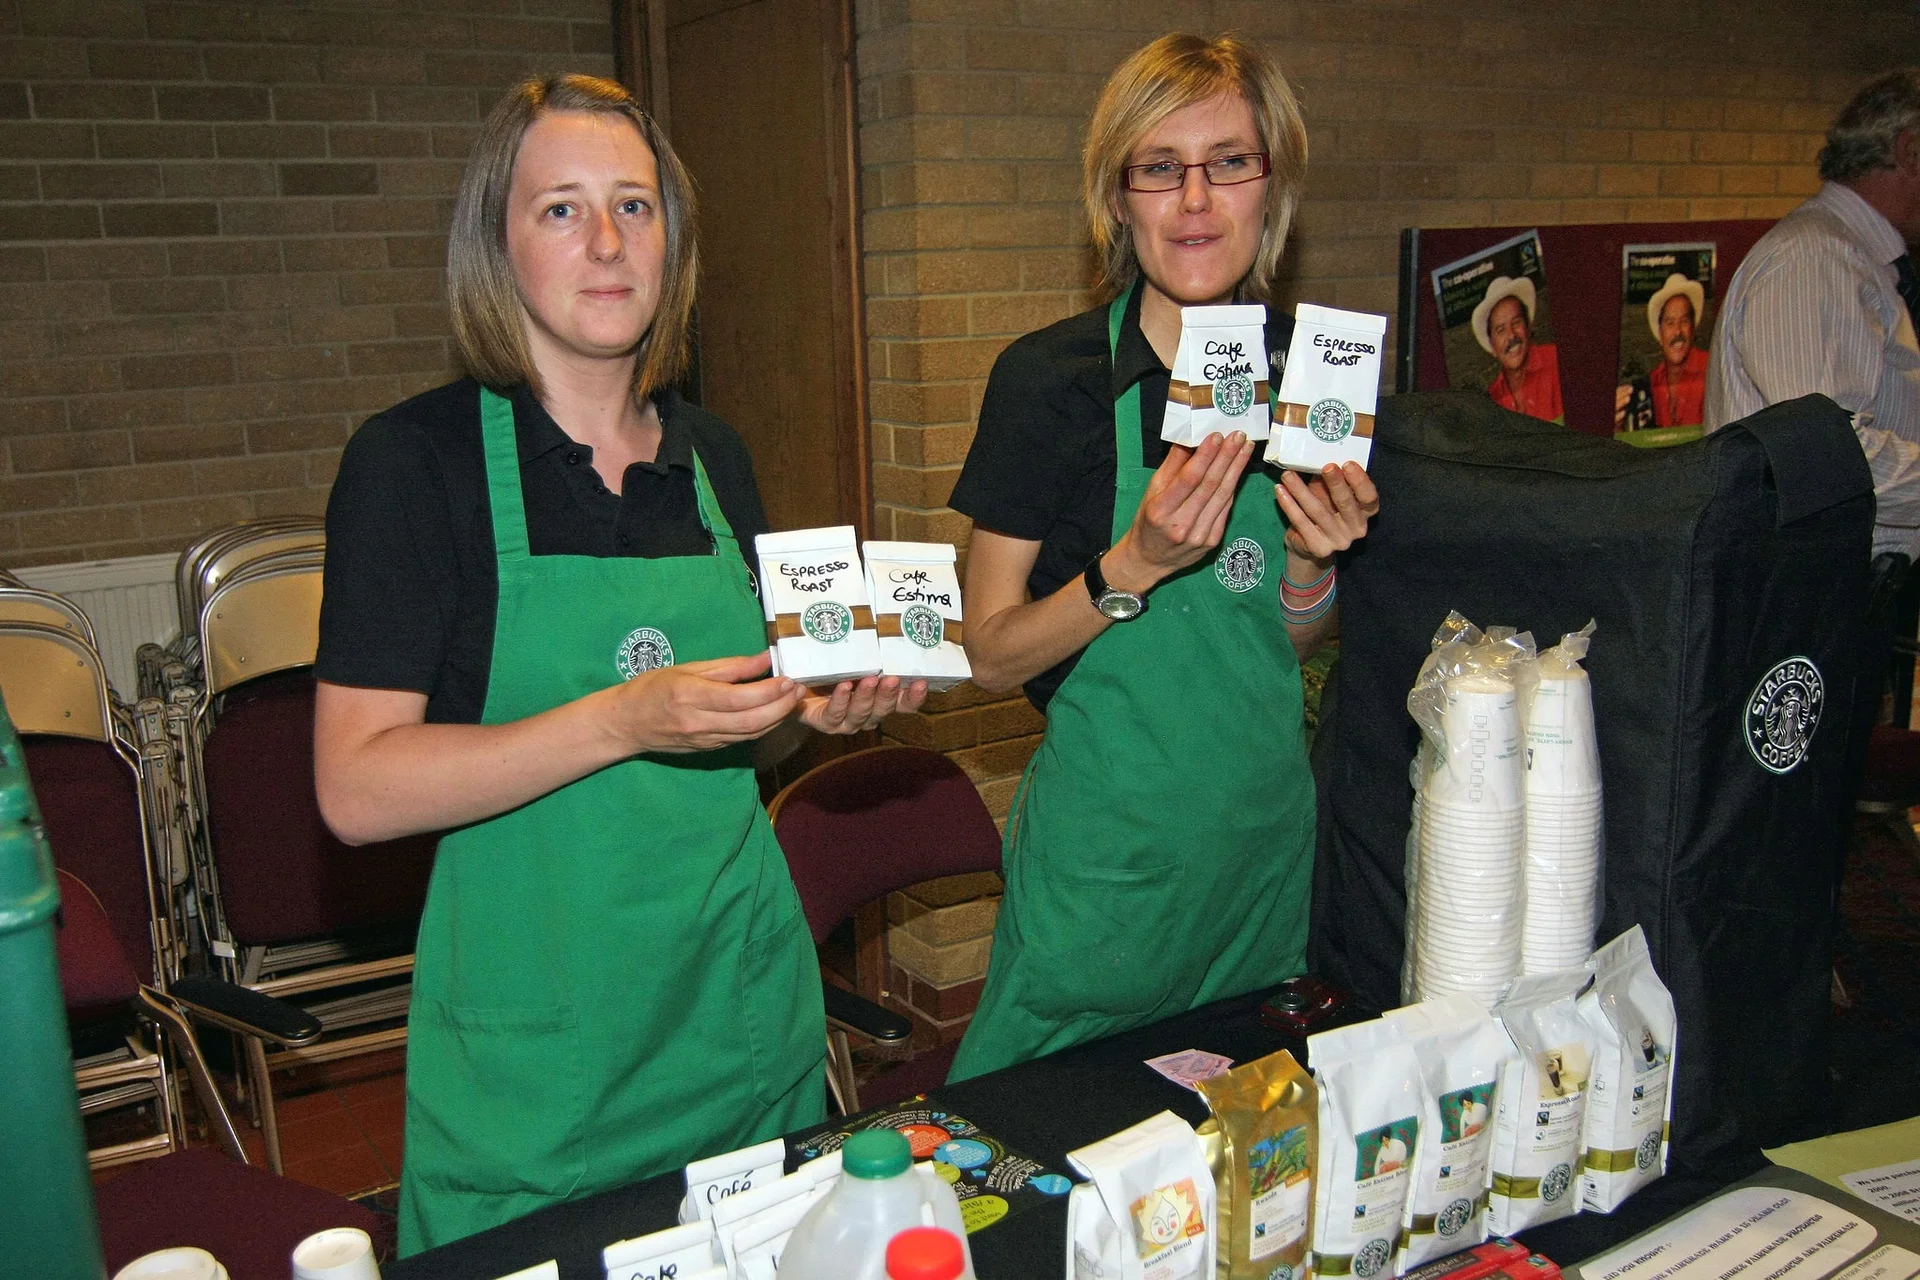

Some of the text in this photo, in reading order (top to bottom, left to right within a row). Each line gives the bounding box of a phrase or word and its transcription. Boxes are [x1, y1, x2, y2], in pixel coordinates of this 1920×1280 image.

[1313, 334, 1376, 354] ESPRESSO
[1322, 350, 1362, 366] ROAST
[1221, 403, 1248, 416] COFFEE
[1312, 401, 1351, 422] STARBUCKS
[1314, 427, 1344, 441] COFFEE
[780, 561, 849, 578] ESPRESSO
[792, 577, 835, 593] ROAST
[1223, 576, 1257, 590] COFFEE
[892, 585, 953, 608] Estima
[805, 603, 848, 623] STARBUCKS
[905, 605, 941, 629] STARBUCKS
[620, 630, 670, 657] STARBUCKS
[813, 628, 846, 642] COFFEE
[1752, 664, 1822, 717] STARBUCKS
[1761, 733, 1808, 767] COFFEE
[1801, 1245, 1820, 1262] ARE
[1815, 1221, 1859, 1249] FAIRTRADE
[1143, 1238, 1193, 1269] Breakfast Blend
